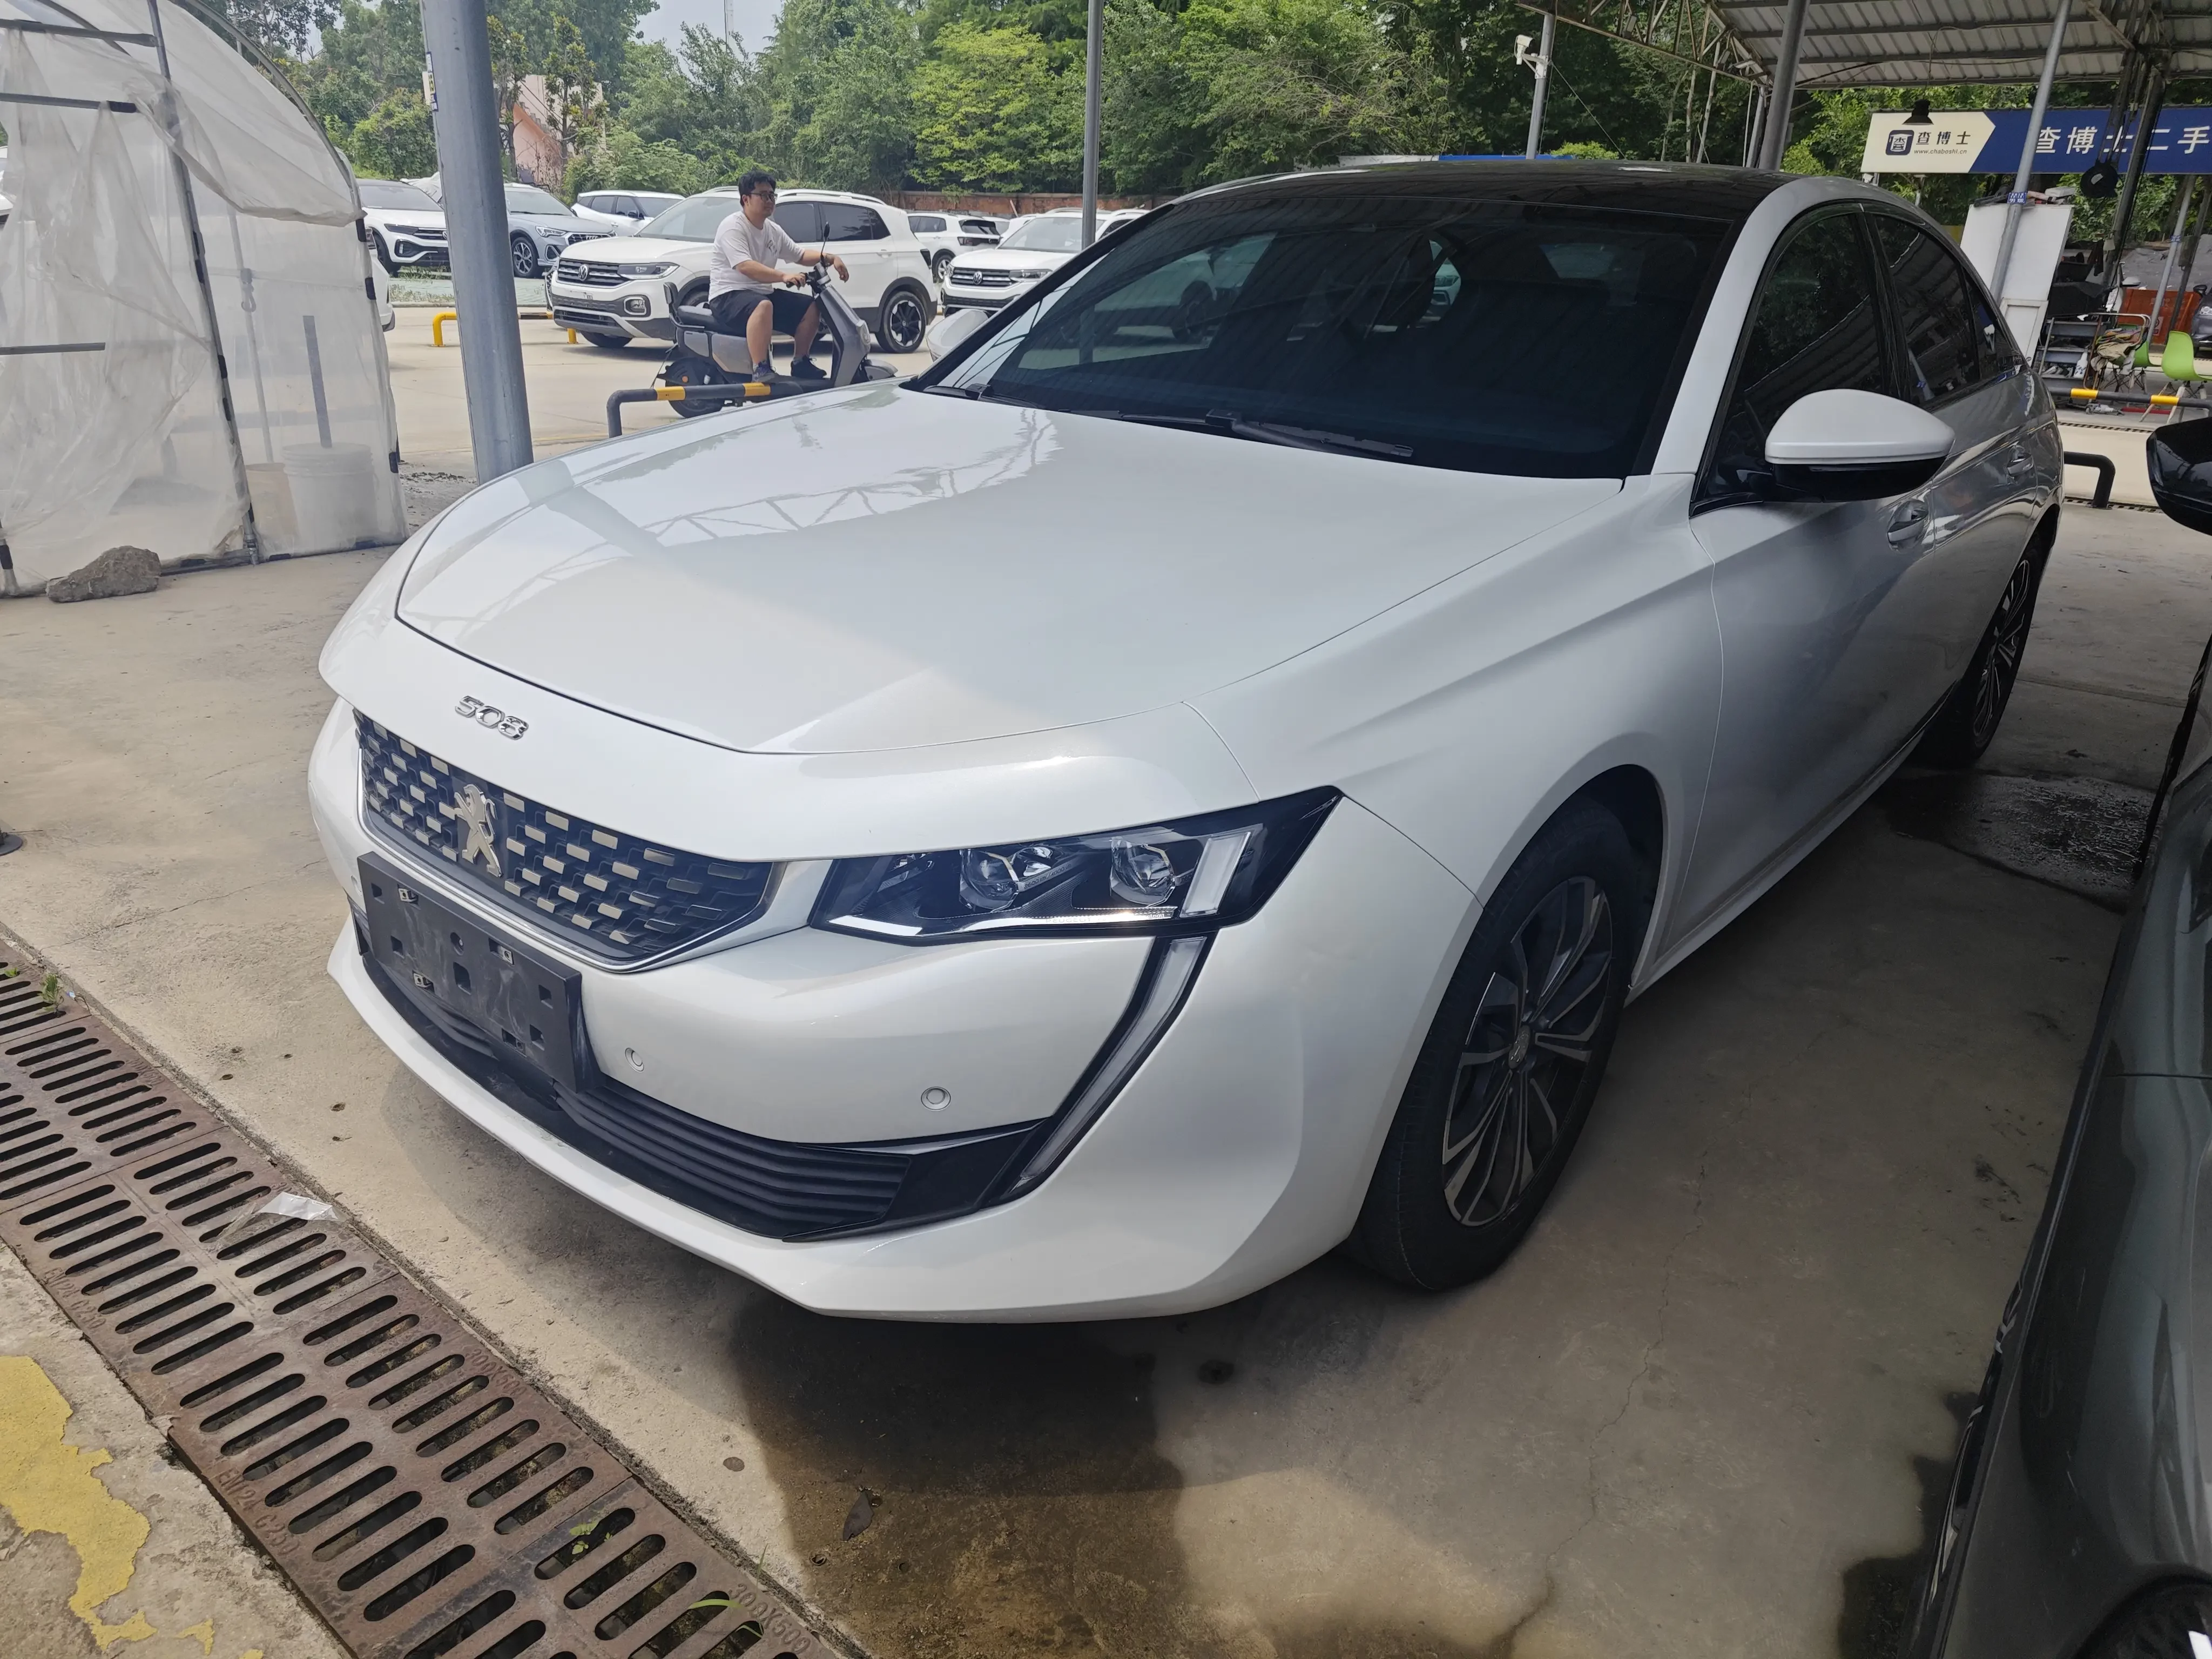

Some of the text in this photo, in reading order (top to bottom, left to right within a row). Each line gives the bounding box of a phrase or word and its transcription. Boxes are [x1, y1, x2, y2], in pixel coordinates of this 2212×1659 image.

[1916, 131, 1971, 145] 查博士
[2035, 125, 2211, 154] 查博士二手
[455, 695, 529, 740] 508
[255, 1514, 300, 1557] C250
